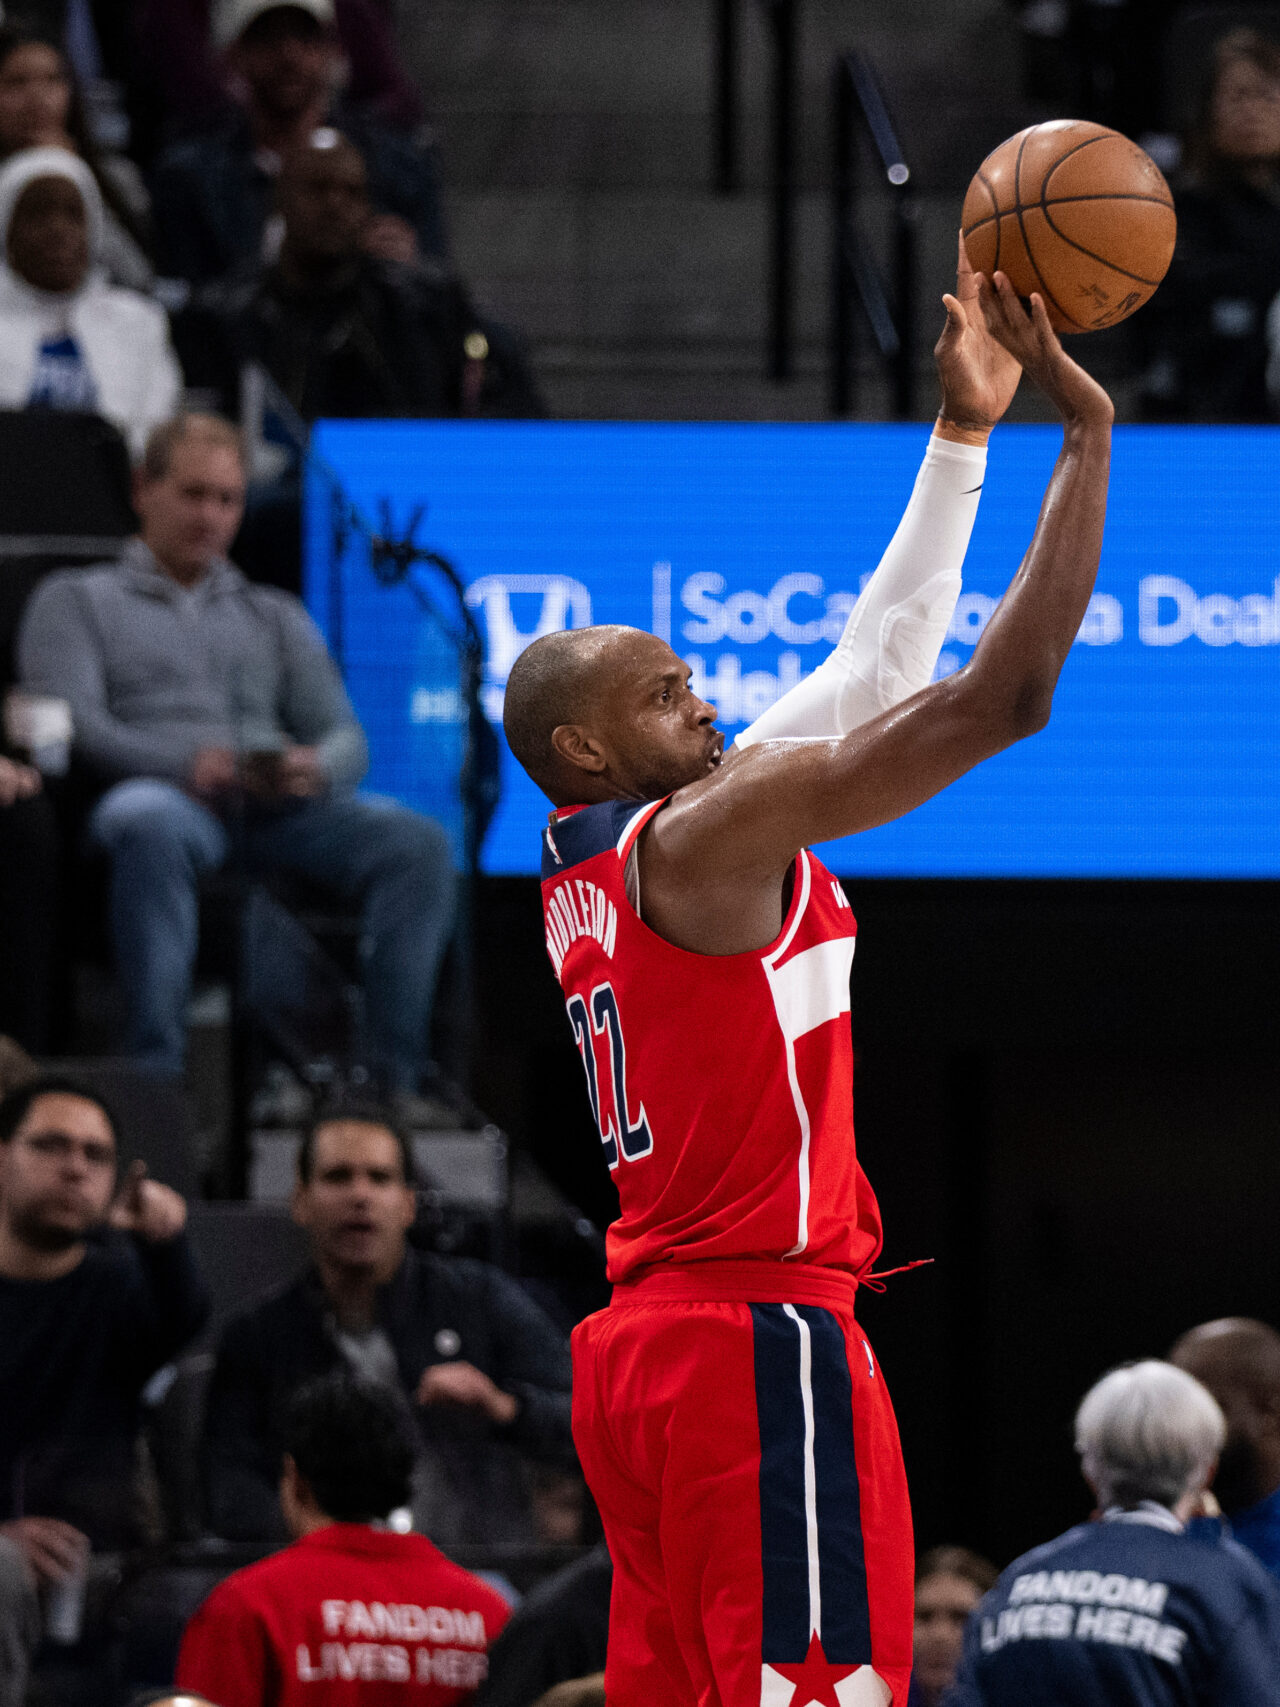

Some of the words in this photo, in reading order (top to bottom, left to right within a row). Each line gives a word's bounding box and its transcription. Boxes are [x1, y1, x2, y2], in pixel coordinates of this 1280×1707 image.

[566, 981, 654, 1170] 22
[1008, 1570, 1168, 1618] FANDOM
[321, 1598, 488, 1649] FANDOM
[980, 1603, 1075, 1653] LIVES
[1075, 1605, 1188, 1666] HERE
[296, 1642, 411, 1683] LIVES
